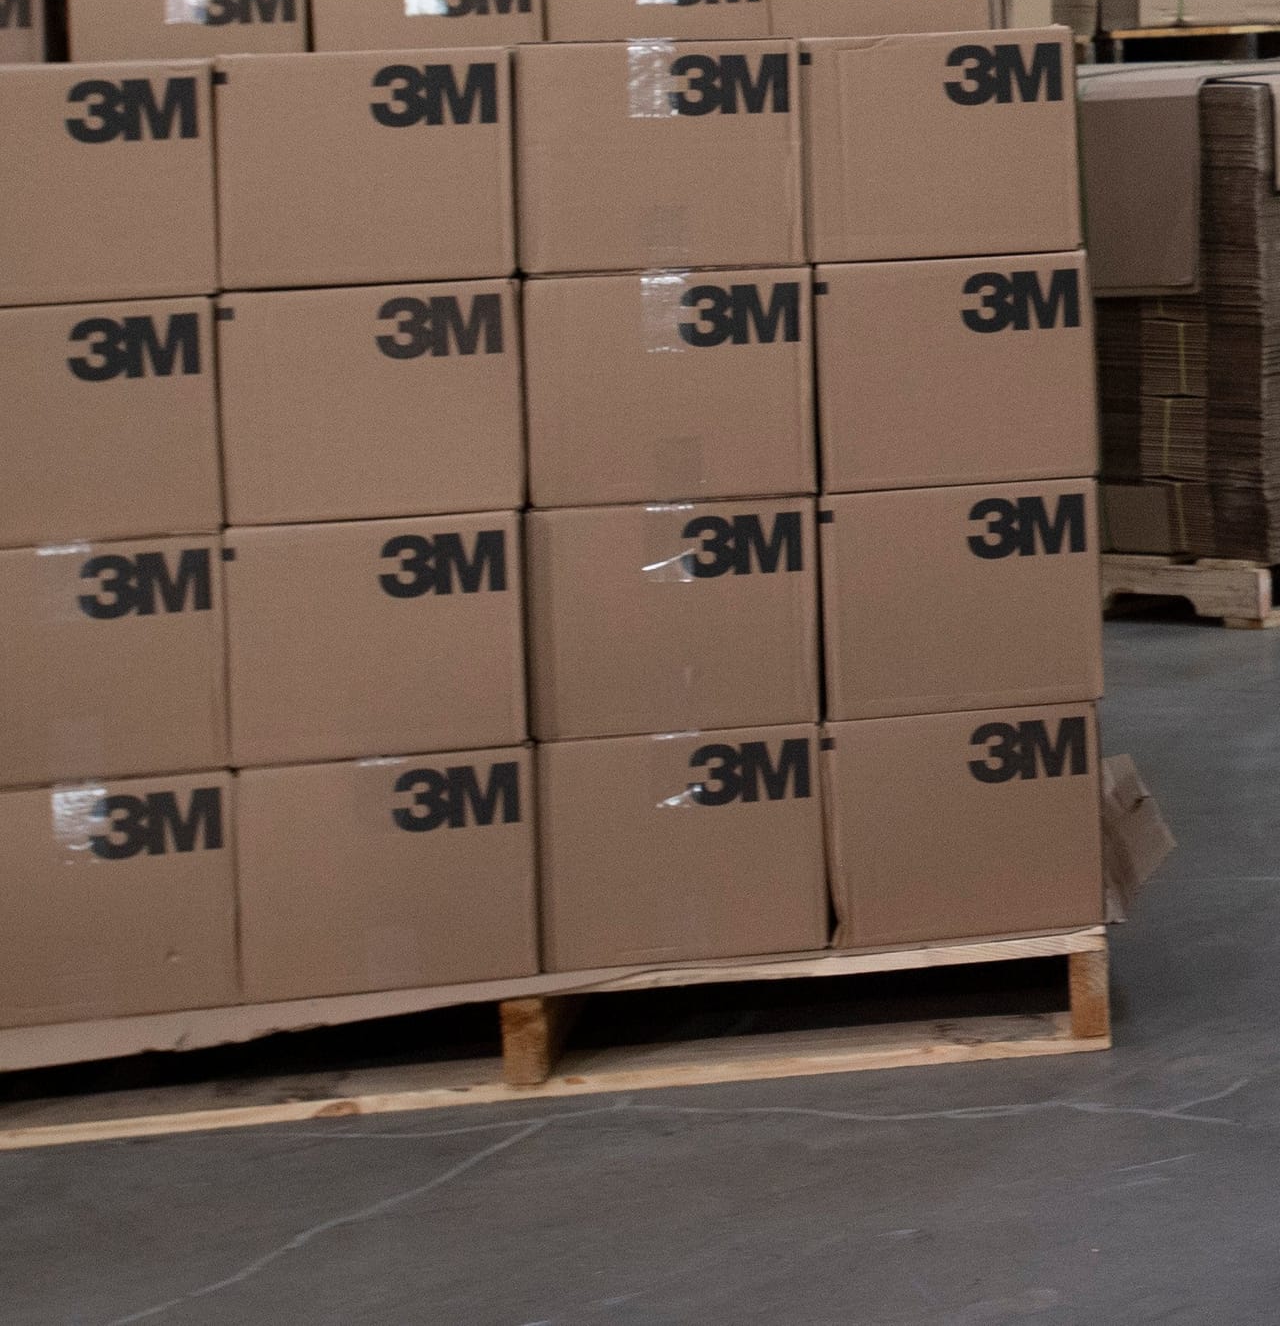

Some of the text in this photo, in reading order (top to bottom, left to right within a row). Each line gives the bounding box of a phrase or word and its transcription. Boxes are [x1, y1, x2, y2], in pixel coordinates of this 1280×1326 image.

[371, 63, 497, 127] 3M
[671, 53, 789, 116] 3M
[945, 43, 1063, 105] 3M
[66, 77, 198, 143] 3M
[376, 294, 503, 359] 3M
[680, 282, 800, 347] 3M
[962, 269, 1080, 333] 3M
[68, 313, 200, 381] 3M
[683, 512, 803, 578] 3M
[968, 494, 1086, 559] 3M
[79, 549, 212, 619] 3M
[380, 530, 506, 598] 3M
[690, 738, 811, 806] 3M
[969, 717, 1088, 783] 3M
[90, 787, 223, 860] 3M
[393, 762, 520, 832] 3M
